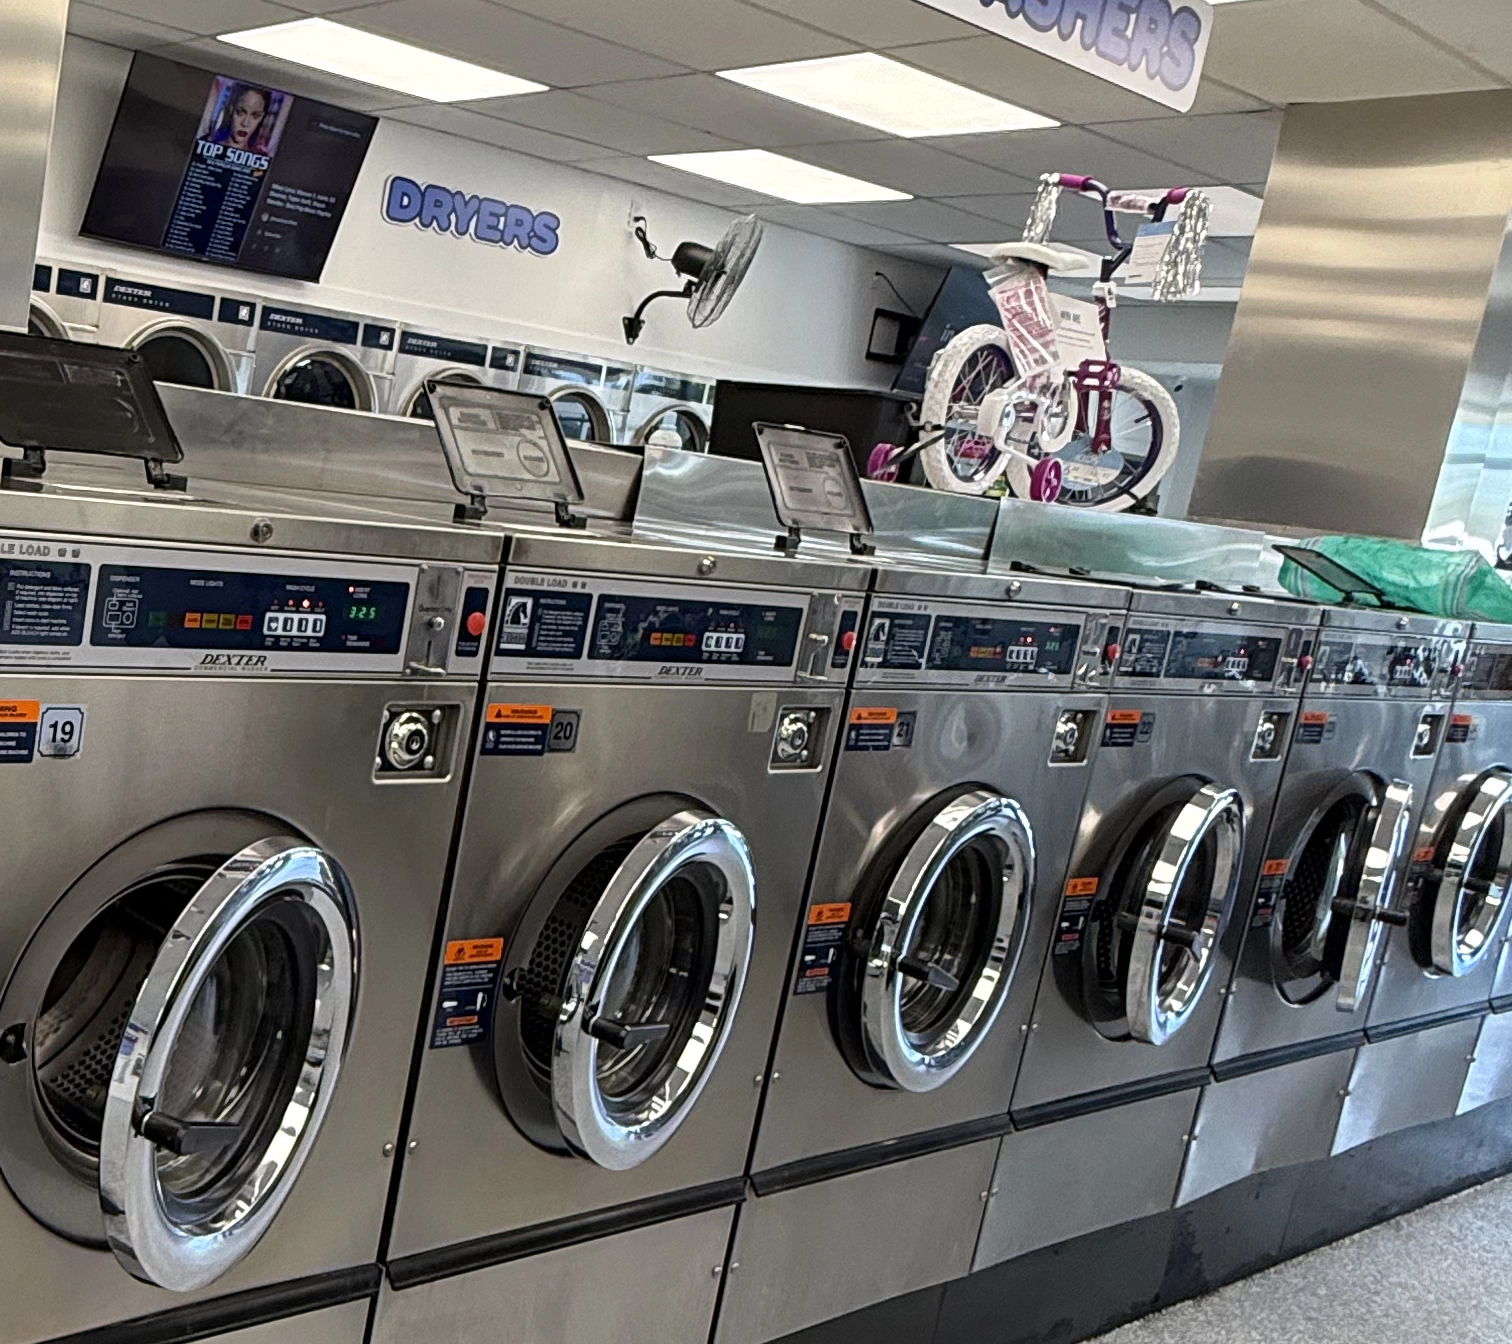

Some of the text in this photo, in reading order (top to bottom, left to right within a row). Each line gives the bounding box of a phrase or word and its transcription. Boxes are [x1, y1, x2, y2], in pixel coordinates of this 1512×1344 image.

[196, 140, 224, 158] TOP
[225, 148, 270, 170] SONGS
[387, 175, 561, 256] DRYERS
[113, 285, 153, 298] DEXTER
[268, 312, 303, 325] DEXTER
[19, 544, 51, 556] LOAD
[513, 575, 568, 589] DOUBLE LOAD
[349, 606, 376, 619] 3.25
[199, 653, 268, 666] DEXTER
[657, 665, 704, 676] DEXTER
[49, 720, 75, 744] 19
[553, 721, 574, 740] 20
